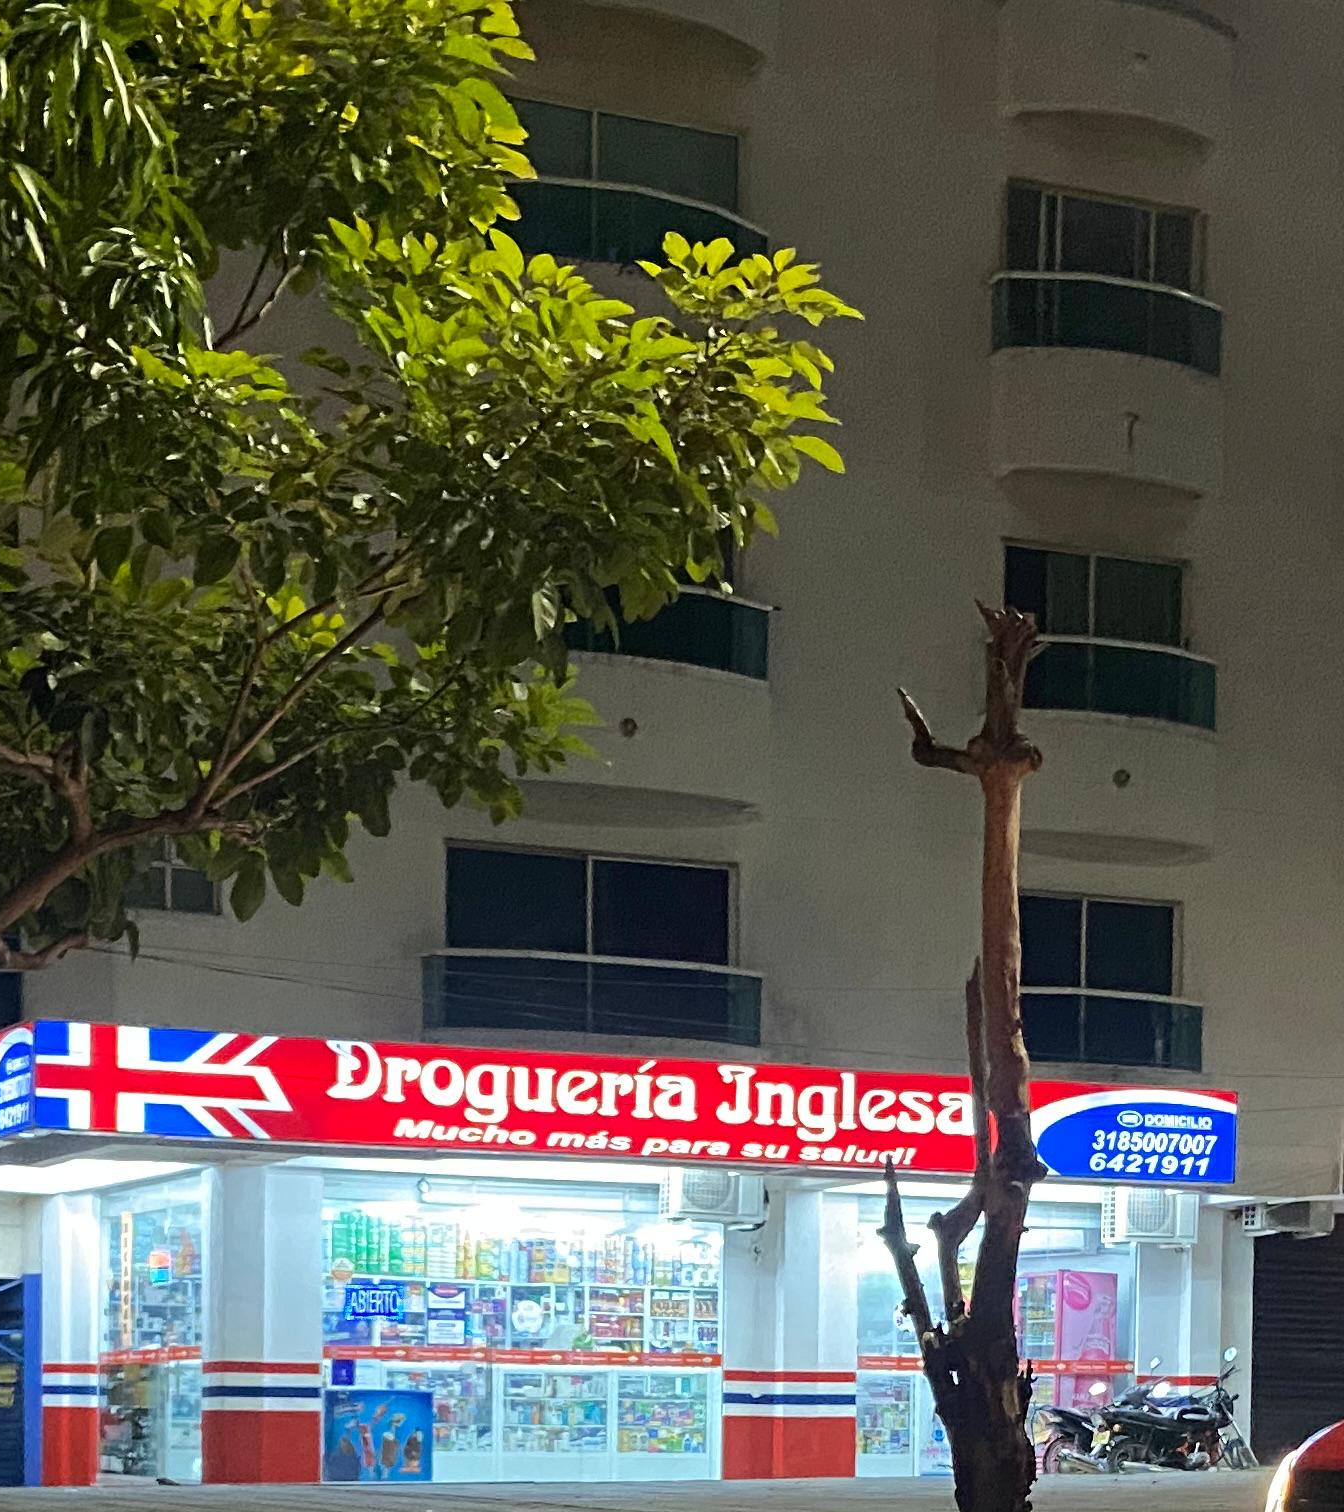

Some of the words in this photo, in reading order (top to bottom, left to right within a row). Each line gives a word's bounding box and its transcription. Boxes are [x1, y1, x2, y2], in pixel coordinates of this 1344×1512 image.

[326, 1040, 697, 1123] Droguería
[716, 1064, 976, 1142] Inglesa
[1144, 1114, 1213, 1130] DOMICILIO
[394, 1118, 536, 1145] Mucho
[547, 1130, 632, 1151] más
[641, 1136, 731, 1157] para
[740, 1141, 789, 1160] su
[798, 1145, 918, 1165] salud!
[1092, 1130, 1218, 1155] 3185007007
[1089, 1153, 1210, 1176] 6421911
[350, 1289, 400, 1313] ABIERTO
